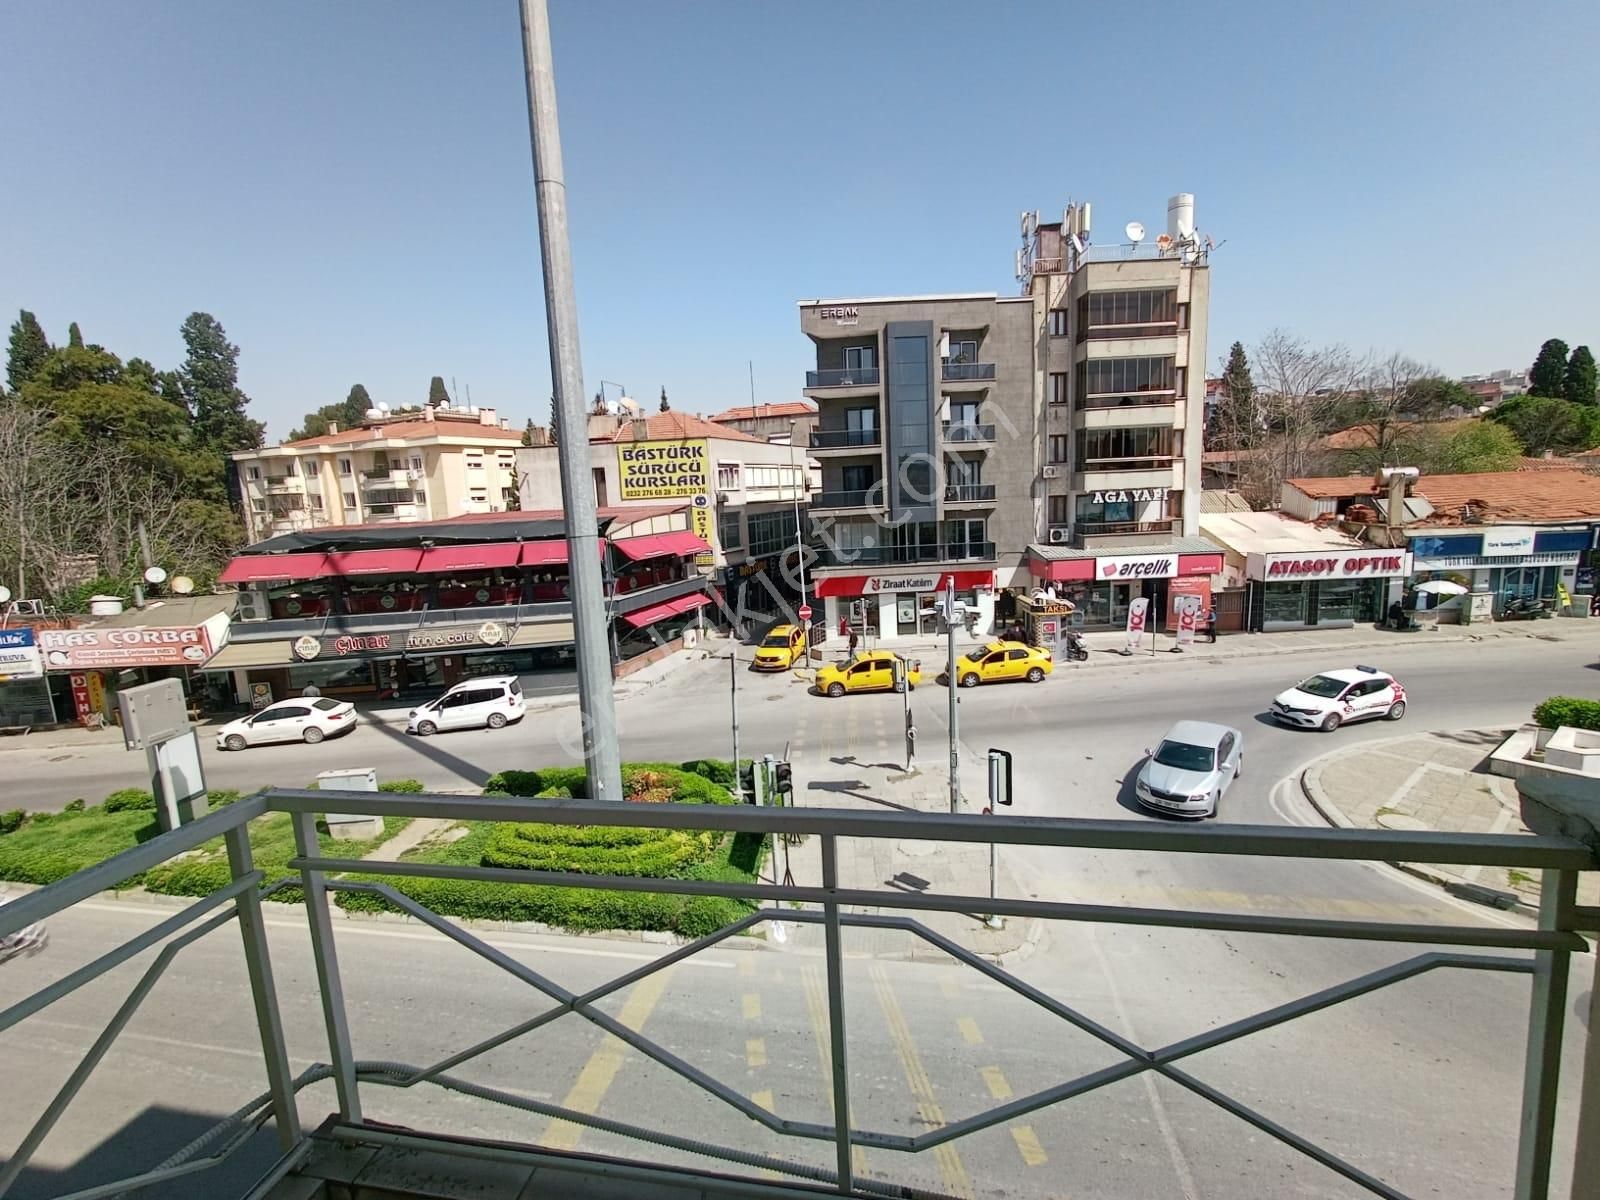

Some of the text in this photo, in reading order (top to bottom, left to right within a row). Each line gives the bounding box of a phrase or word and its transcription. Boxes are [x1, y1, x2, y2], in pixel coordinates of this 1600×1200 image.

[622, 444, 704, 461] BASTÜRK
[627, 459, 701, 476] SÜRÜCÜ
[624, 474, 706, 488] KURSLARI
[1118, 559, 1172, 578] arçelik
[1268, 558, 1339, 576] ATASOY
[882, 577, 933, 589] Ziraat Katılım
[45, 629, 199, 649] HAS ÇORBA
[447, 631, 475, 644] cafe
